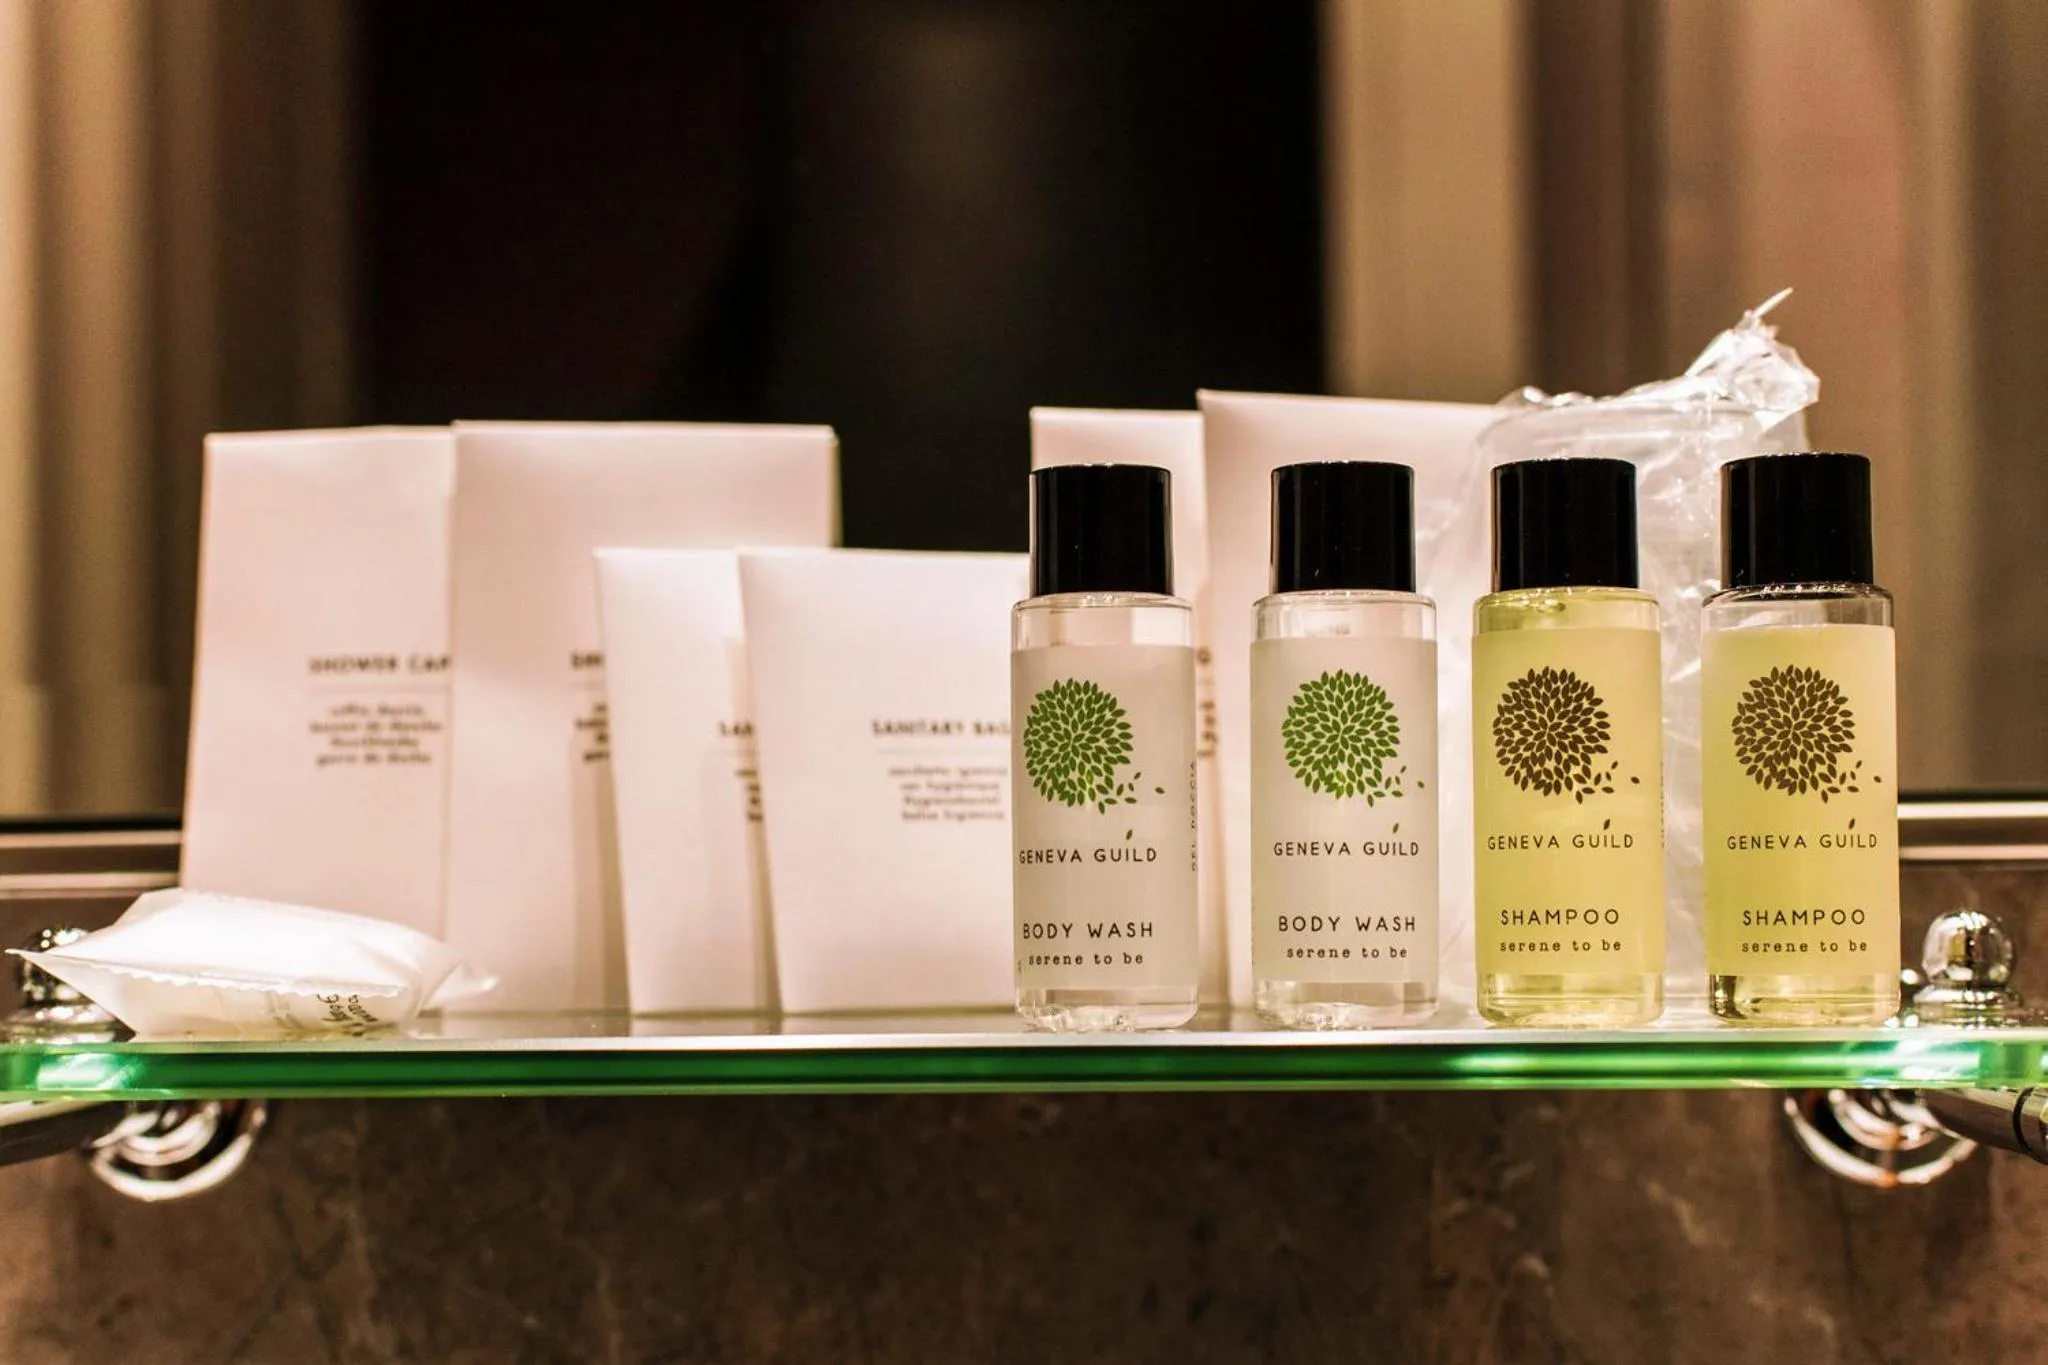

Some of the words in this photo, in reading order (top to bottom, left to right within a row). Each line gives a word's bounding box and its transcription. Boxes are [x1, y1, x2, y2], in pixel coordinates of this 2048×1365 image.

[1273, 841, 1352, 857] GENEVA
[1362, 841, 1420, 857] GUILD
[1487, 834, 1560, 851] GENEVA
[1572, 833, 1634, 849] GUILD
[1726, 834, 1808, 851] GENEVA
[1818, 833, 1878, 849] GUILD
[1018, 848, 1083, 865] GENEVA
[1093, 847, 1158, 863] GUILD
[1277, 914, 1341, 933] BODY
[1355, 915, 1416, 933] WASH
[1499, 908, 1620, 926] SHAMPOO
[1742, 908, 1866, 927] SHAMPOO
[1022, 921, 1074, 940] BODY
[1087, 921, 1154, 939] WASH
[1286, 947, 1352, 959] serene
[1361, 947, 1380, 959] to
[1389, 946, 1408, 959] be
[1499, 941, 1562, 953] serene
[1572, 940, 1592, 952] to
[1601, 938, 1622, 952] be
[1741, 942, 1809, 953] serene
[1819, 940, 1839, 953] to
[1848, 939, 1868, 953] be
[1028, 955, 1083, 966] serene
[1093, 953, 1113, 965] to
[1122, 951, 1144, 965] be
